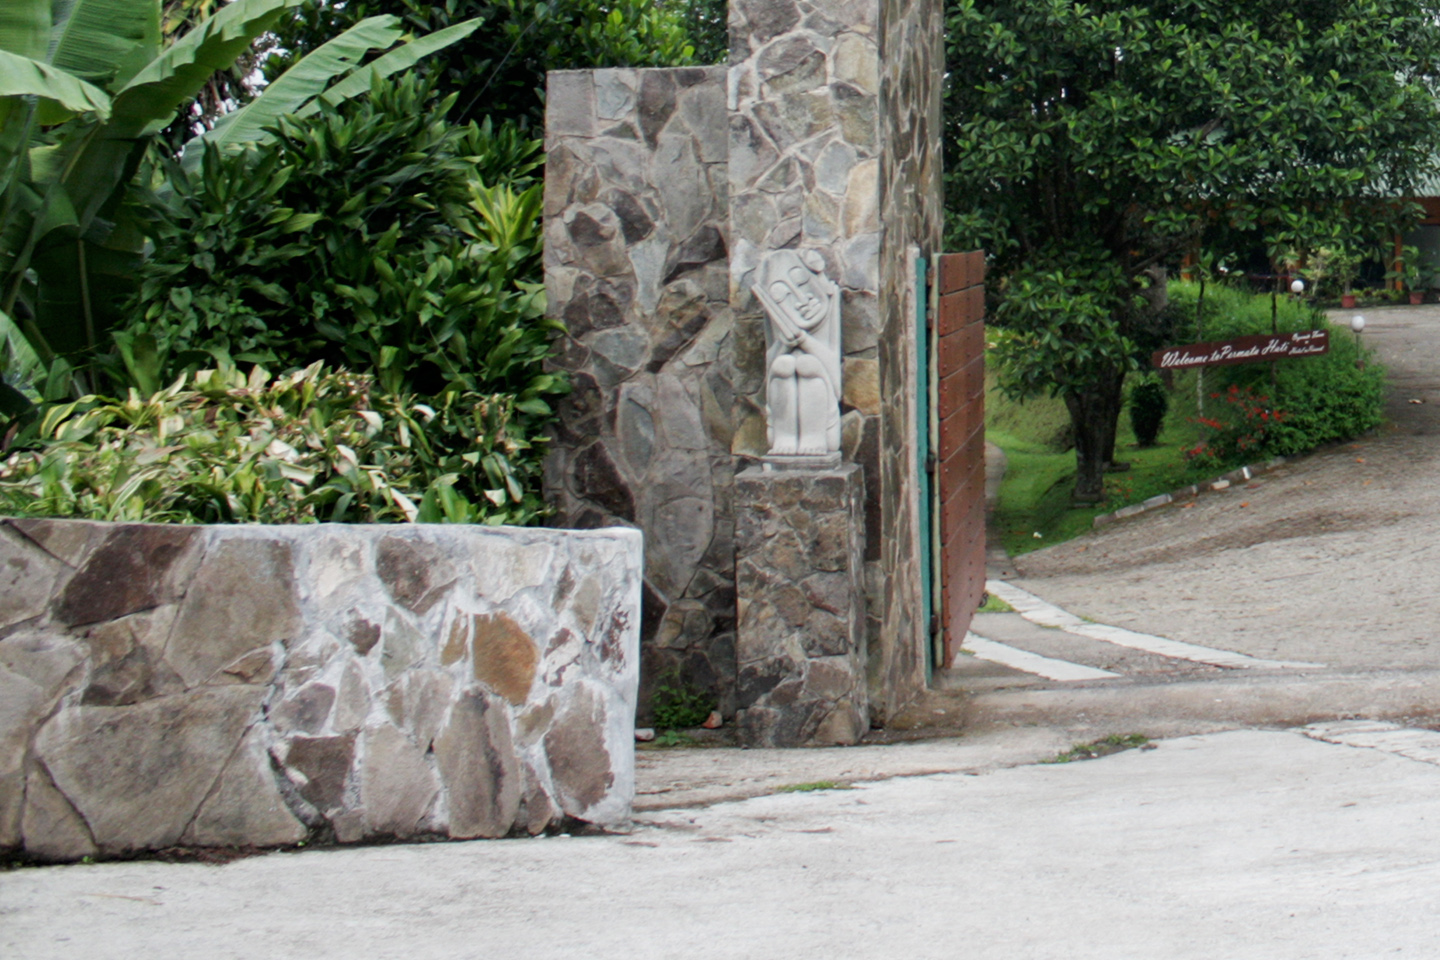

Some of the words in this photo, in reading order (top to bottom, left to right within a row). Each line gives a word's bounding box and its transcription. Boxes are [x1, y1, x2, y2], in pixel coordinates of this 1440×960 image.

[1161, 351, 1208, 368] Welcome
[1220, 345, 1259, 360] Permata
[1262, 339, 1290, 355] Hati
